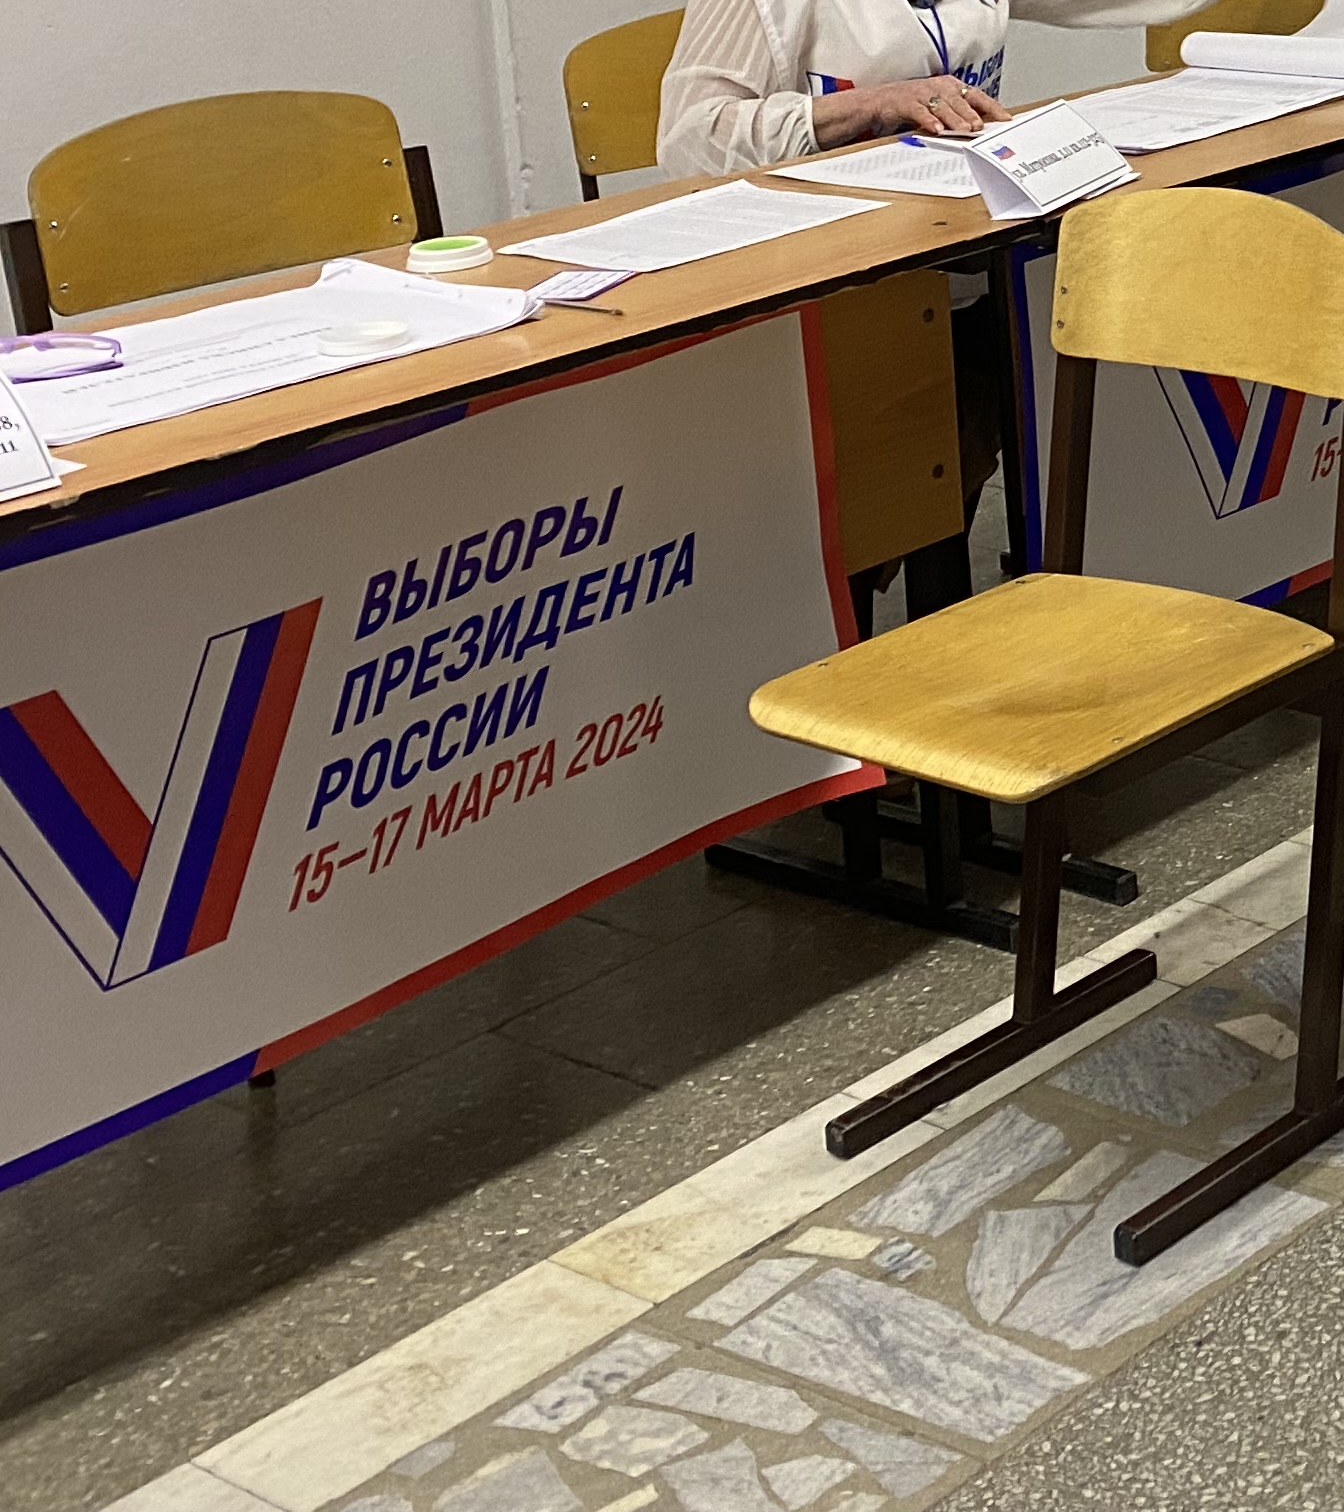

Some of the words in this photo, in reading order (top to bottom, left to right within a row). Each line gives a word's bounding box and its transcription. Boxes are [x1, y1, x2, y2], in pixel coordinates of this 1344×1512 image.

[332, 532, 696, 736] ПРЕЗИДЕНТА
[354, 485, 624, 641] ВЫБОРЫ
[306, 665, 550, 832] РОССИИ
[416, 739, 556, 850] МАРТА
[565, 695, 665, 779] 2024
